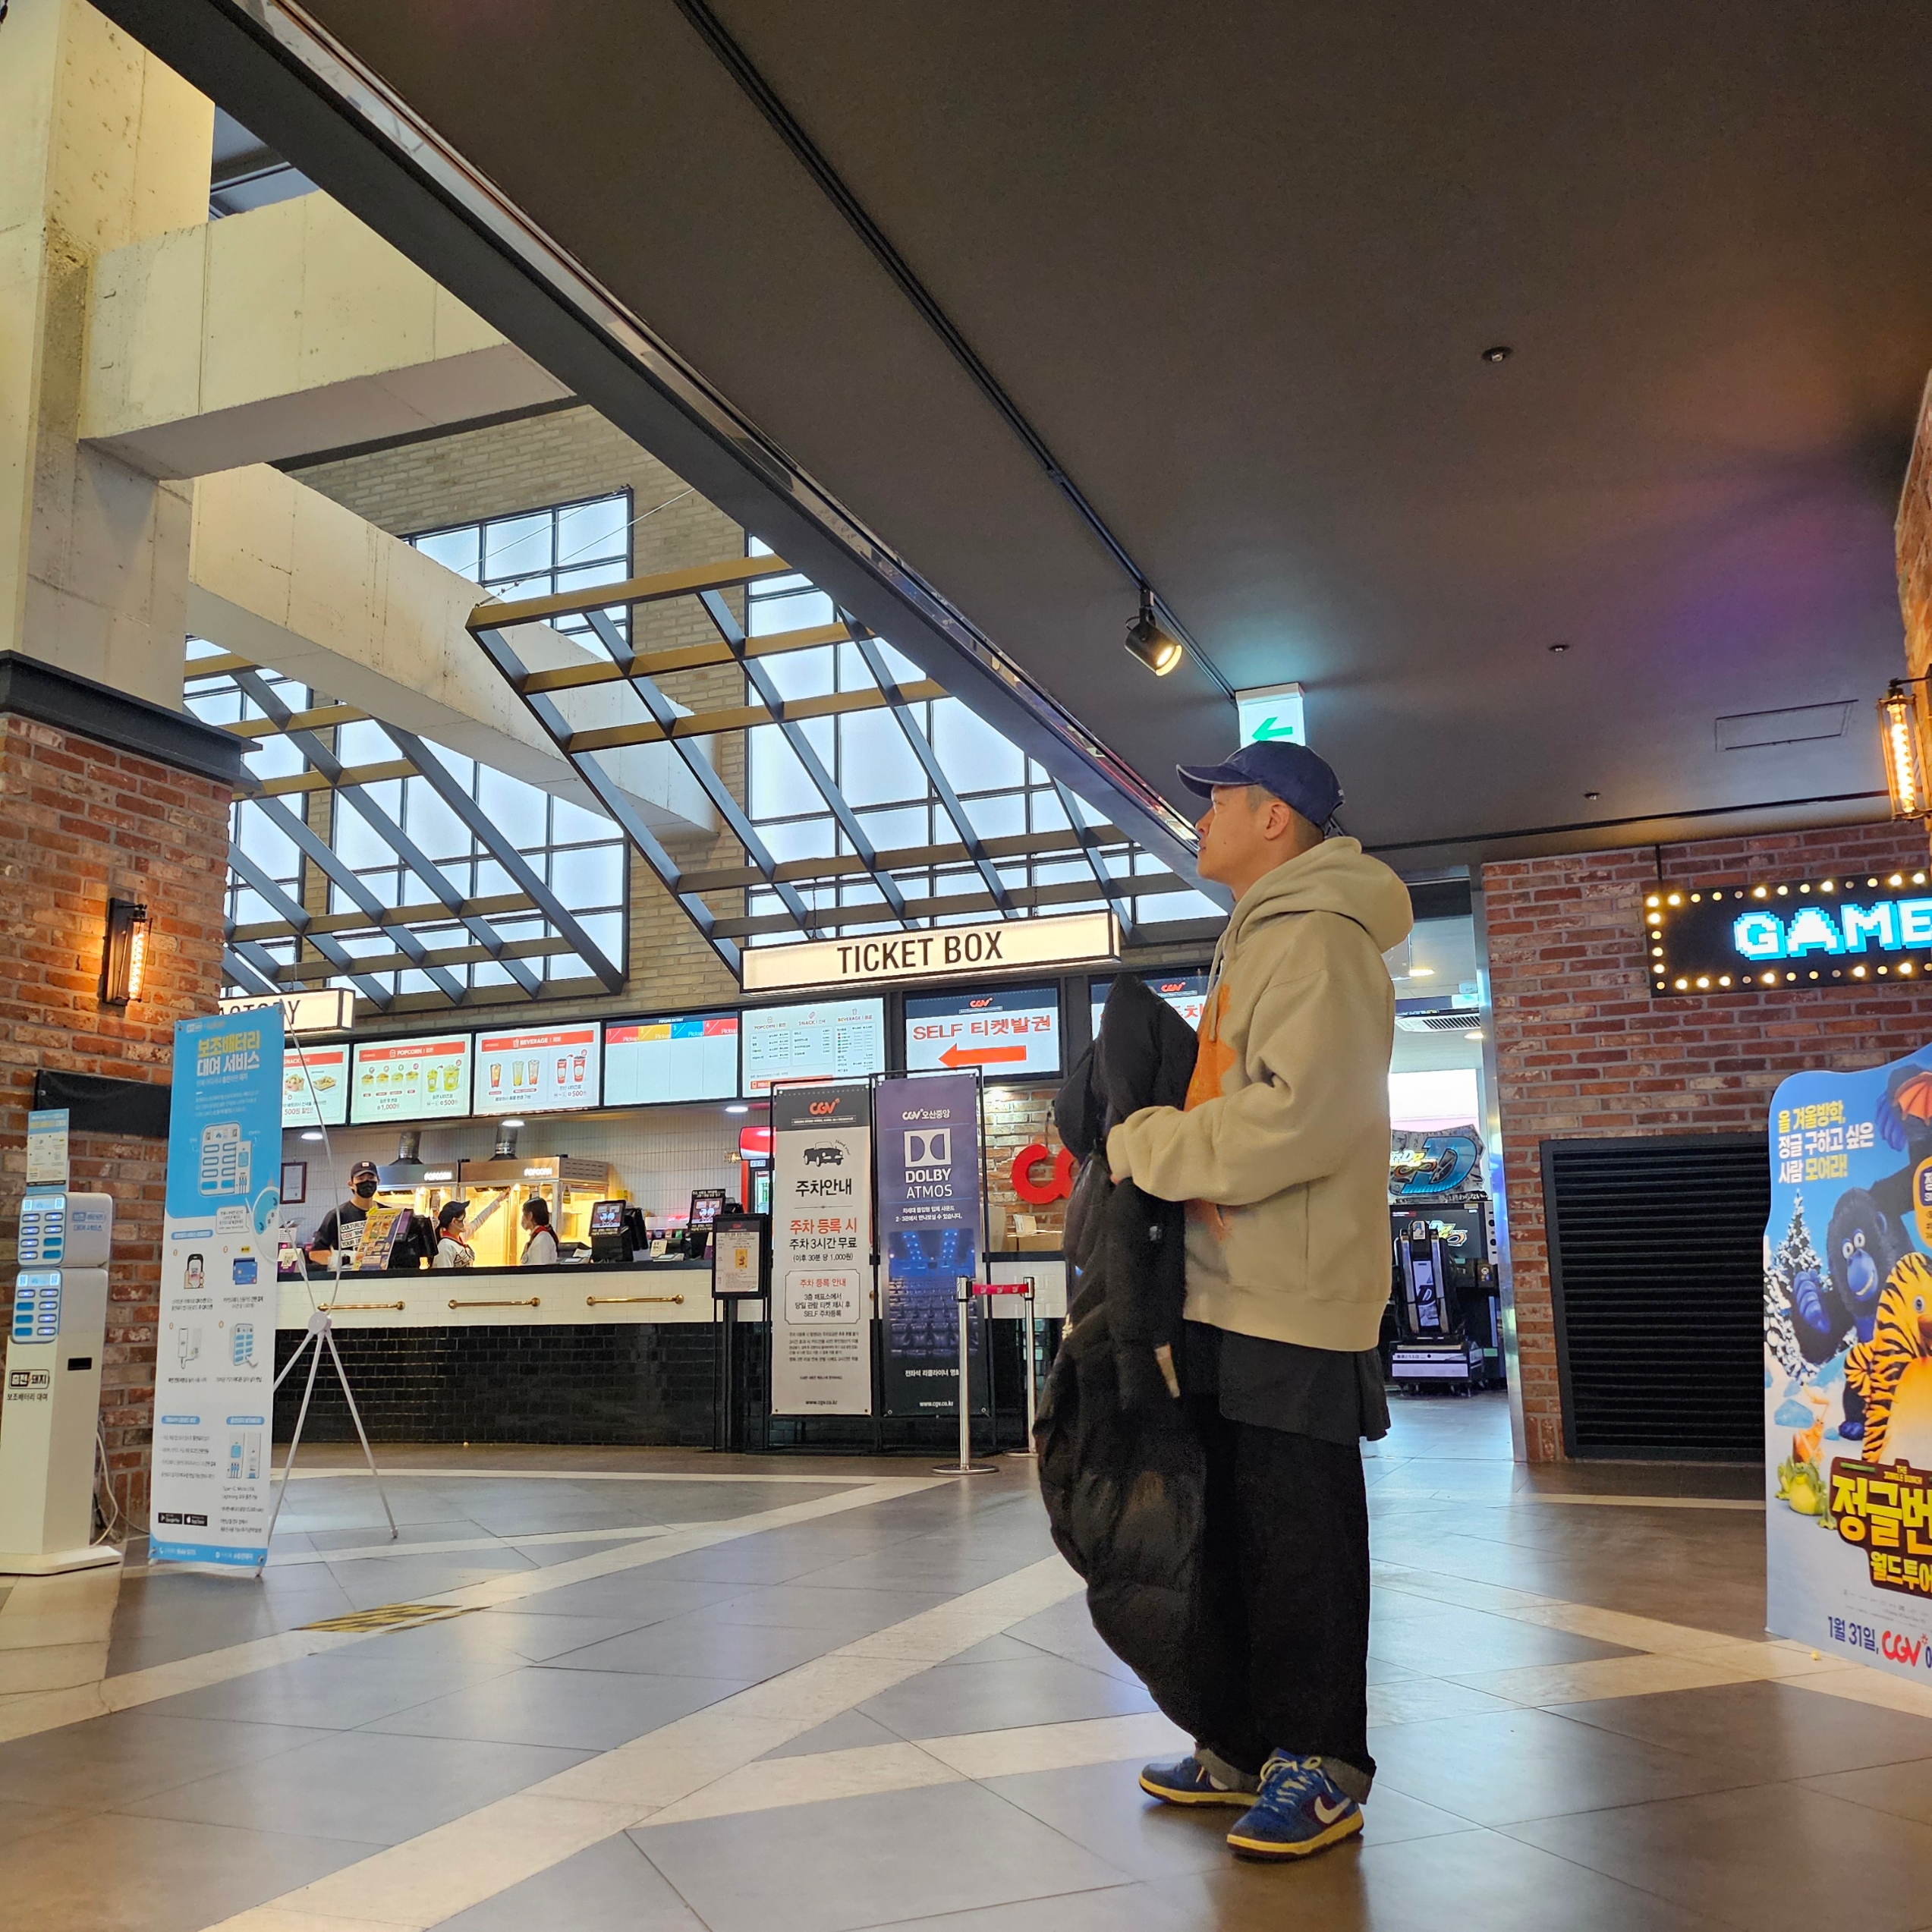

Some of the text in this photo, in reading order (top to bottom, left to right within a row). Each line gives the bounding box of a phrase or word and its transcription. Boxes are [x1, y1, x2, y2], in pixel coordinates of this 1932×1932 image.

[1733, 897, 1932, 961] GAME
[837, 930, 1003, 974] TICKET BOX
[969, 997, 993, 1008] CGV
[913, 1015, 1051, 1040] SELF 티켓발권
[198, 1031, 260, 1059] 보조배터리
[520, 1037, 548, 1046] BEVERAGE
[197, 1051, 260, 1077] 대여 서비스
[809, 1098, 840, 1115] CGV
[902, 1109, 951, 1121] CGV 오산중앙
[1778, 1100, 1846, 1134] 올 겨울방학,
[1778, 1122, 1875, 1160] 정글 구하고 싶은
[524, 1168, 553, 1176] POPCORN
[905, 1168, 952, 1184] DOLBY
[1778, 1154, 1849, 1184] 사람 모여라!
[795, 1178, 852, 1197] 주차안내
[906, 1185, 953, 1200] ATMOS
[789, 1217, 857, 1235] 주차 등록 시
[341, 1238, 355, 1247] YOUR
[789, 1237, 857, 1251] 주차 3시간 무료
[793, 1253, 854, 1263] (이후 30분 당 1,000원)
[800, 1278, 846, 1288] 주차 등록 안내
[804, 1292, 842, 1301] 3층 매표소에서
[795, 1301, 851, 1311] 당일 관람 티켓 제시 후
[820, 1309, 842, 1318] 주차등록
[905, 1369, 921, 1377] 전좌석
[922, 1369, 949, 1377] 리클라이너
[1827, 1616, 1845, 1643] 1월
[1882, 1630, 1923, 1667] CGV
